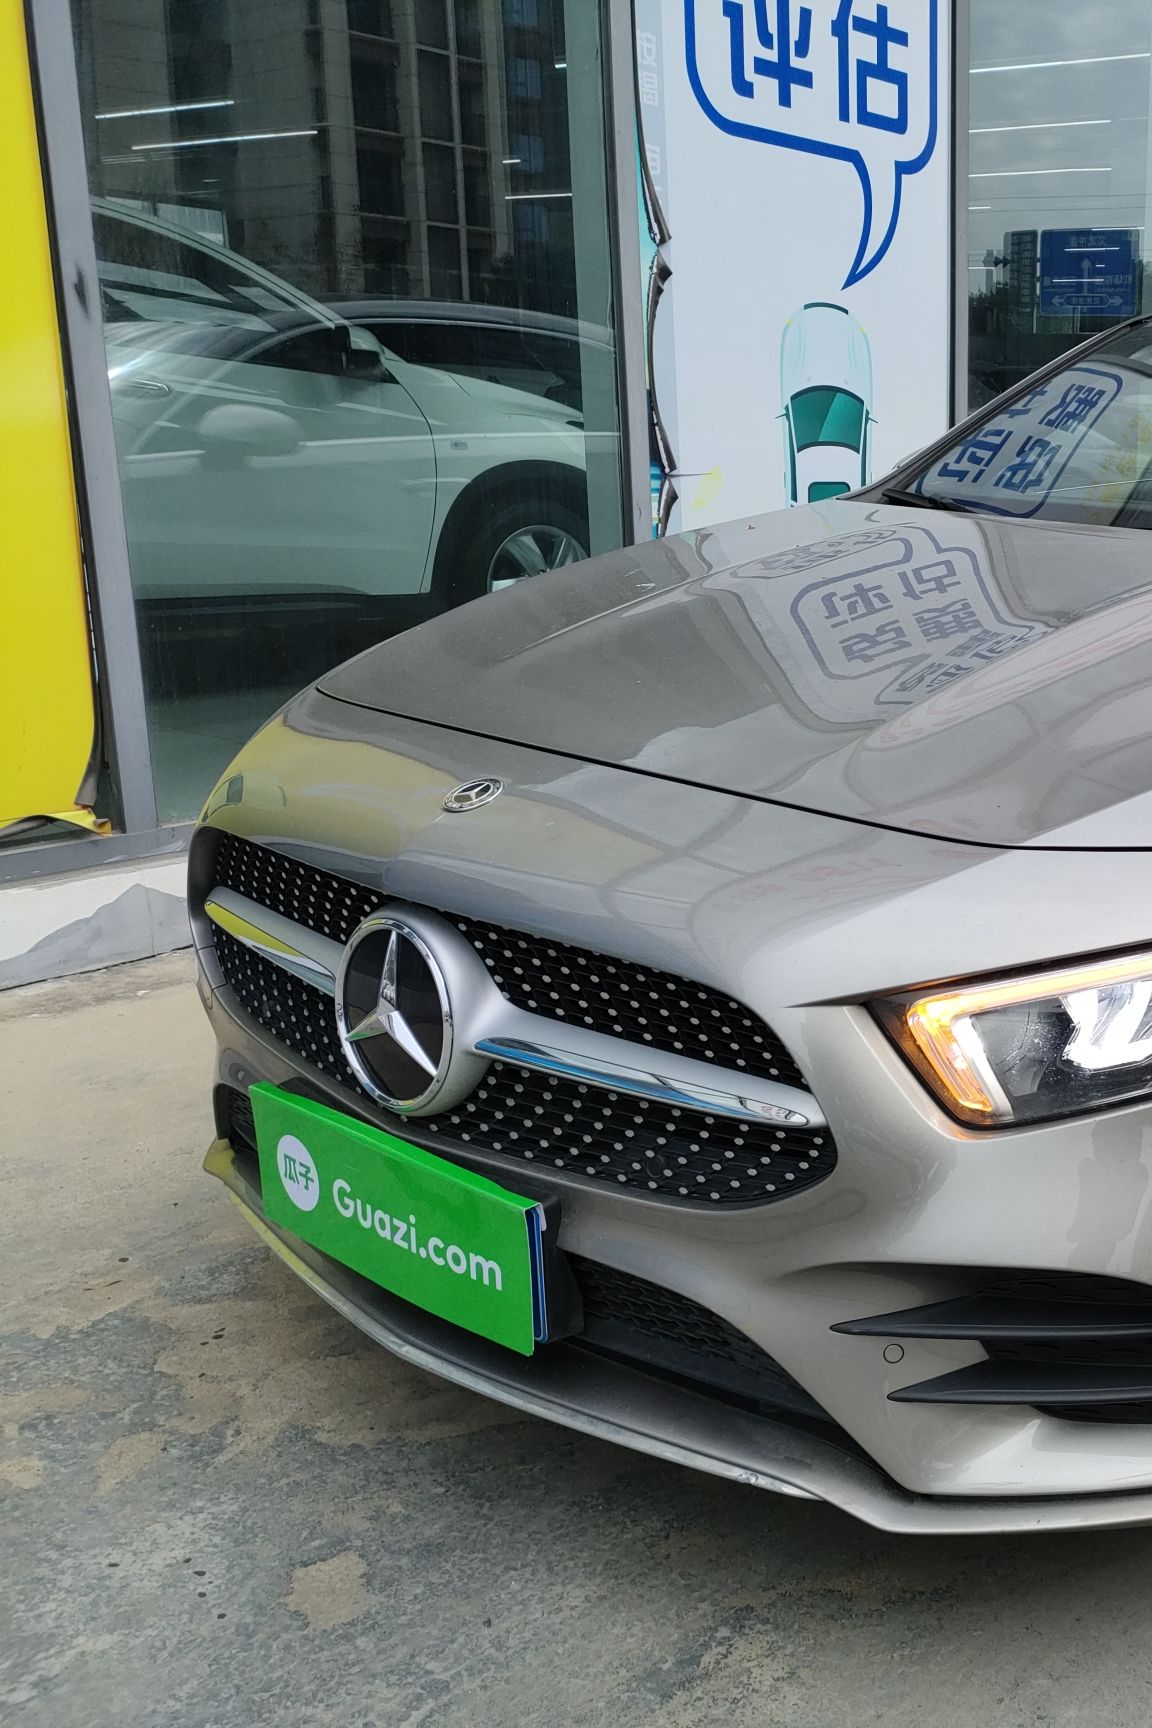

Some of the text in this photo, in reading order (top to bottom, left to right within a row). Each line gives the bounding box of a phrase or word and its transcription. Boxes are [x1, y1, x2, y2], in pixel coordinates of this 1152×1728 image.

[722, 0, 909, 135] 评估
[283, 1152, 314, 1192] 瓜子
[332, 1178, 503, 1291] Guazi.com
